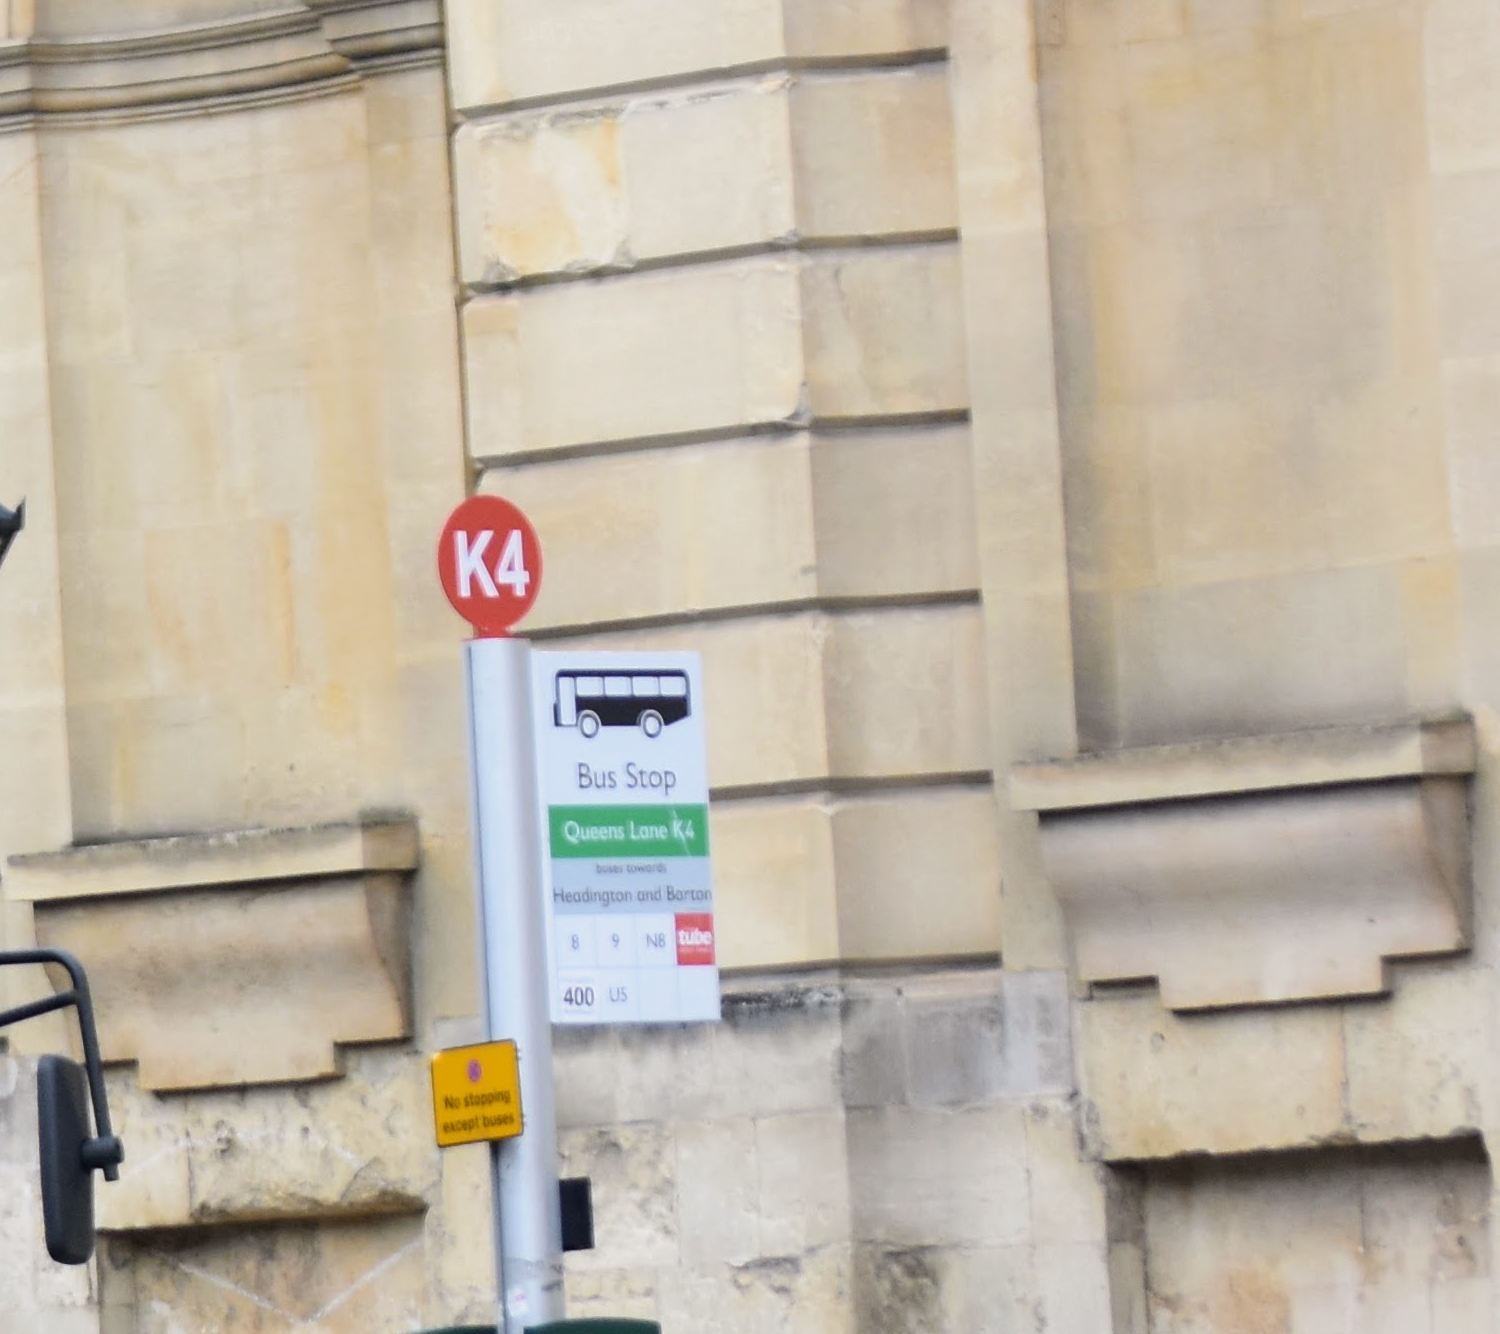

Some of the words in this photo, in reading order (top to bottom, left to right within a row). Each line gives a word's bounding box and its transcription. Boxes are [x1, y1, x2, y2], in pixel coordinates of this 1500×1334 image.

[452, 529, 531, 599] K4
[577, 762, 617, 789] Bus
[626, 761, 677, 795] Stop
[564, 820, 624, 844] Queens
[630, 820, 668, 840] Lane
[672, 819, 695, 840] K4
[553, 886, 632, 907] Headington
[637, 886, 662, 902] and
[667, 884, 712, 902] Barton
[570, 934, 580, 950] 8
[611, 933, 620, 949] 9
[646, 933, 666, 949] N8
[563, 986, 595, 1007] 400
